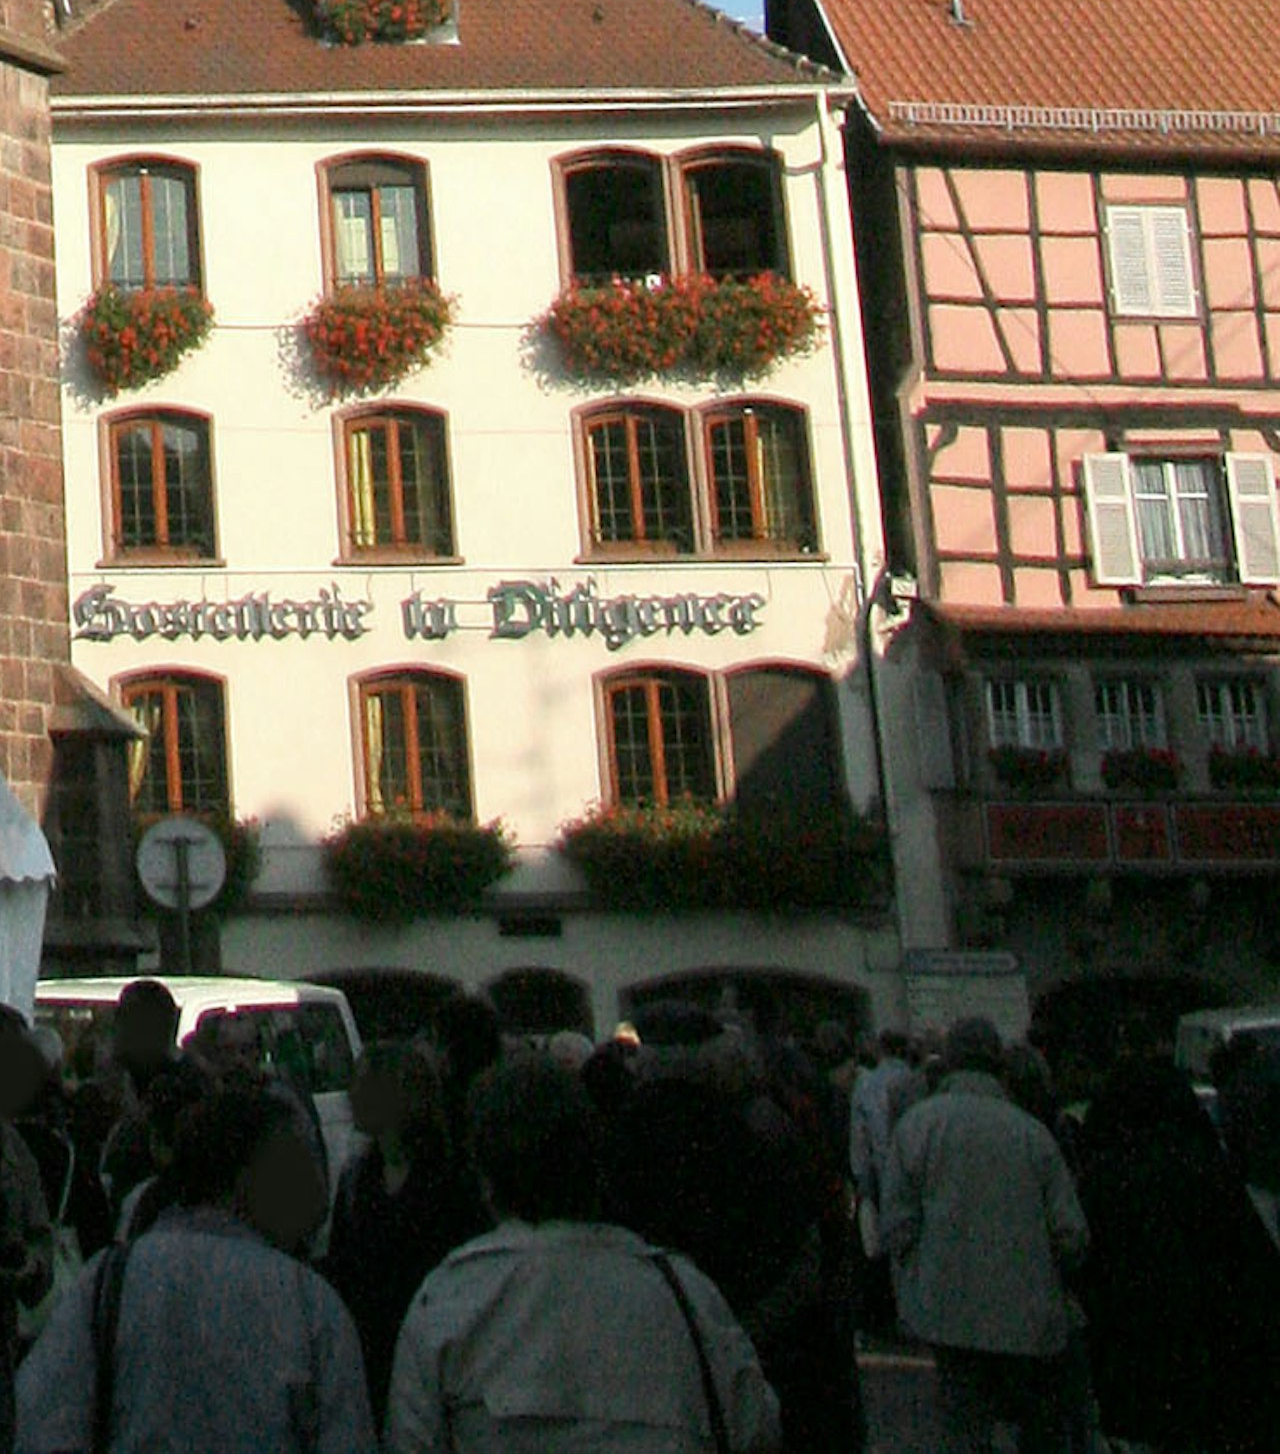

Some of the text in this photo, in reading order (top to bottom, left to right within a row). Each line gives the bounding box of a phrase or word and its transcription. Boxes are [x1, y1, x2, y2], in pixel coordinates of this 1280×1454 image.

[73, 577, 765, 651] Hostellerie la Diligence
